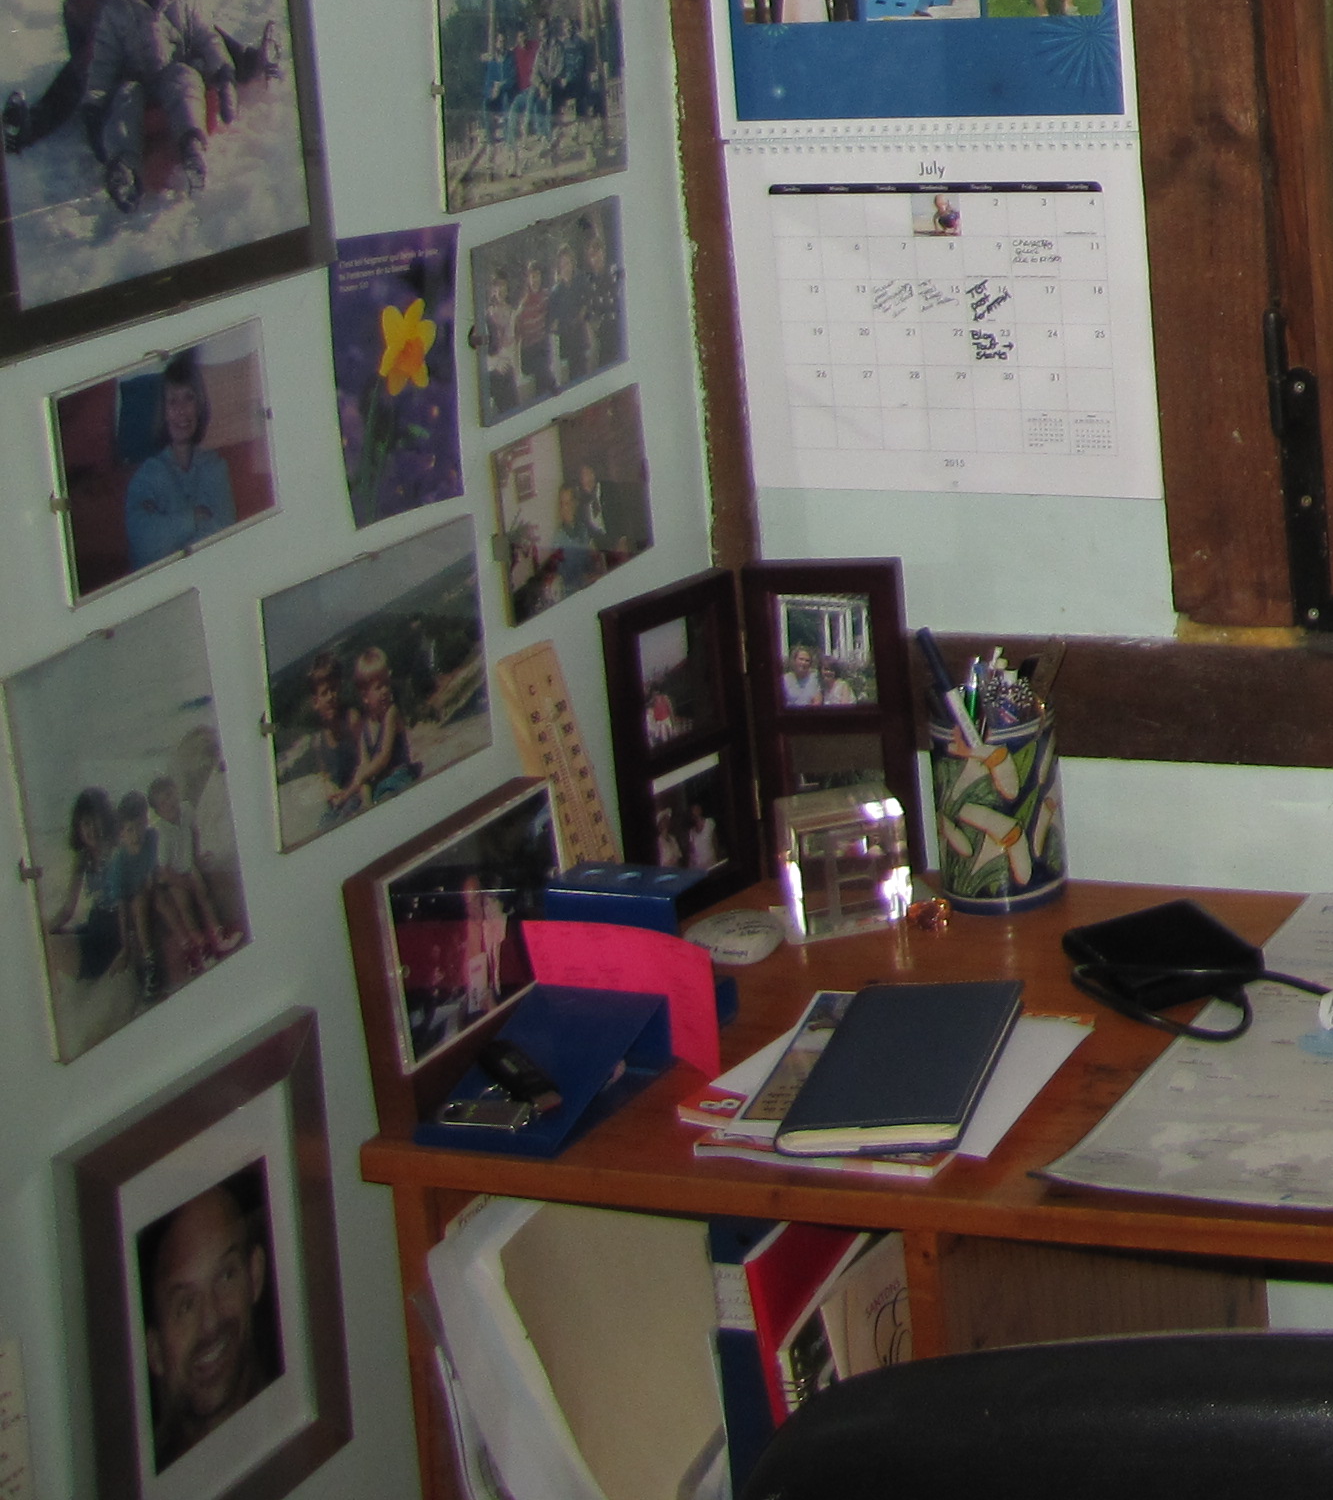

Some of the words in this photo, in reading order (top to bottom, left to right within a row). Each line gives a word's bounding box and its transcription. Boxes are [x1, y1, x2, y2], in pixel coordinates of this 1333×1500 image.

[918, 161, 946, 179] July
[810, 285, 819, 294] 12
[856, 285, 866, 294] 13
[1045, 285, 1055, 294] 17
[906, 328, 916, 337] 21
[970, 329, 996, 344] Blog
[944, 458, 965, 467] 2015
